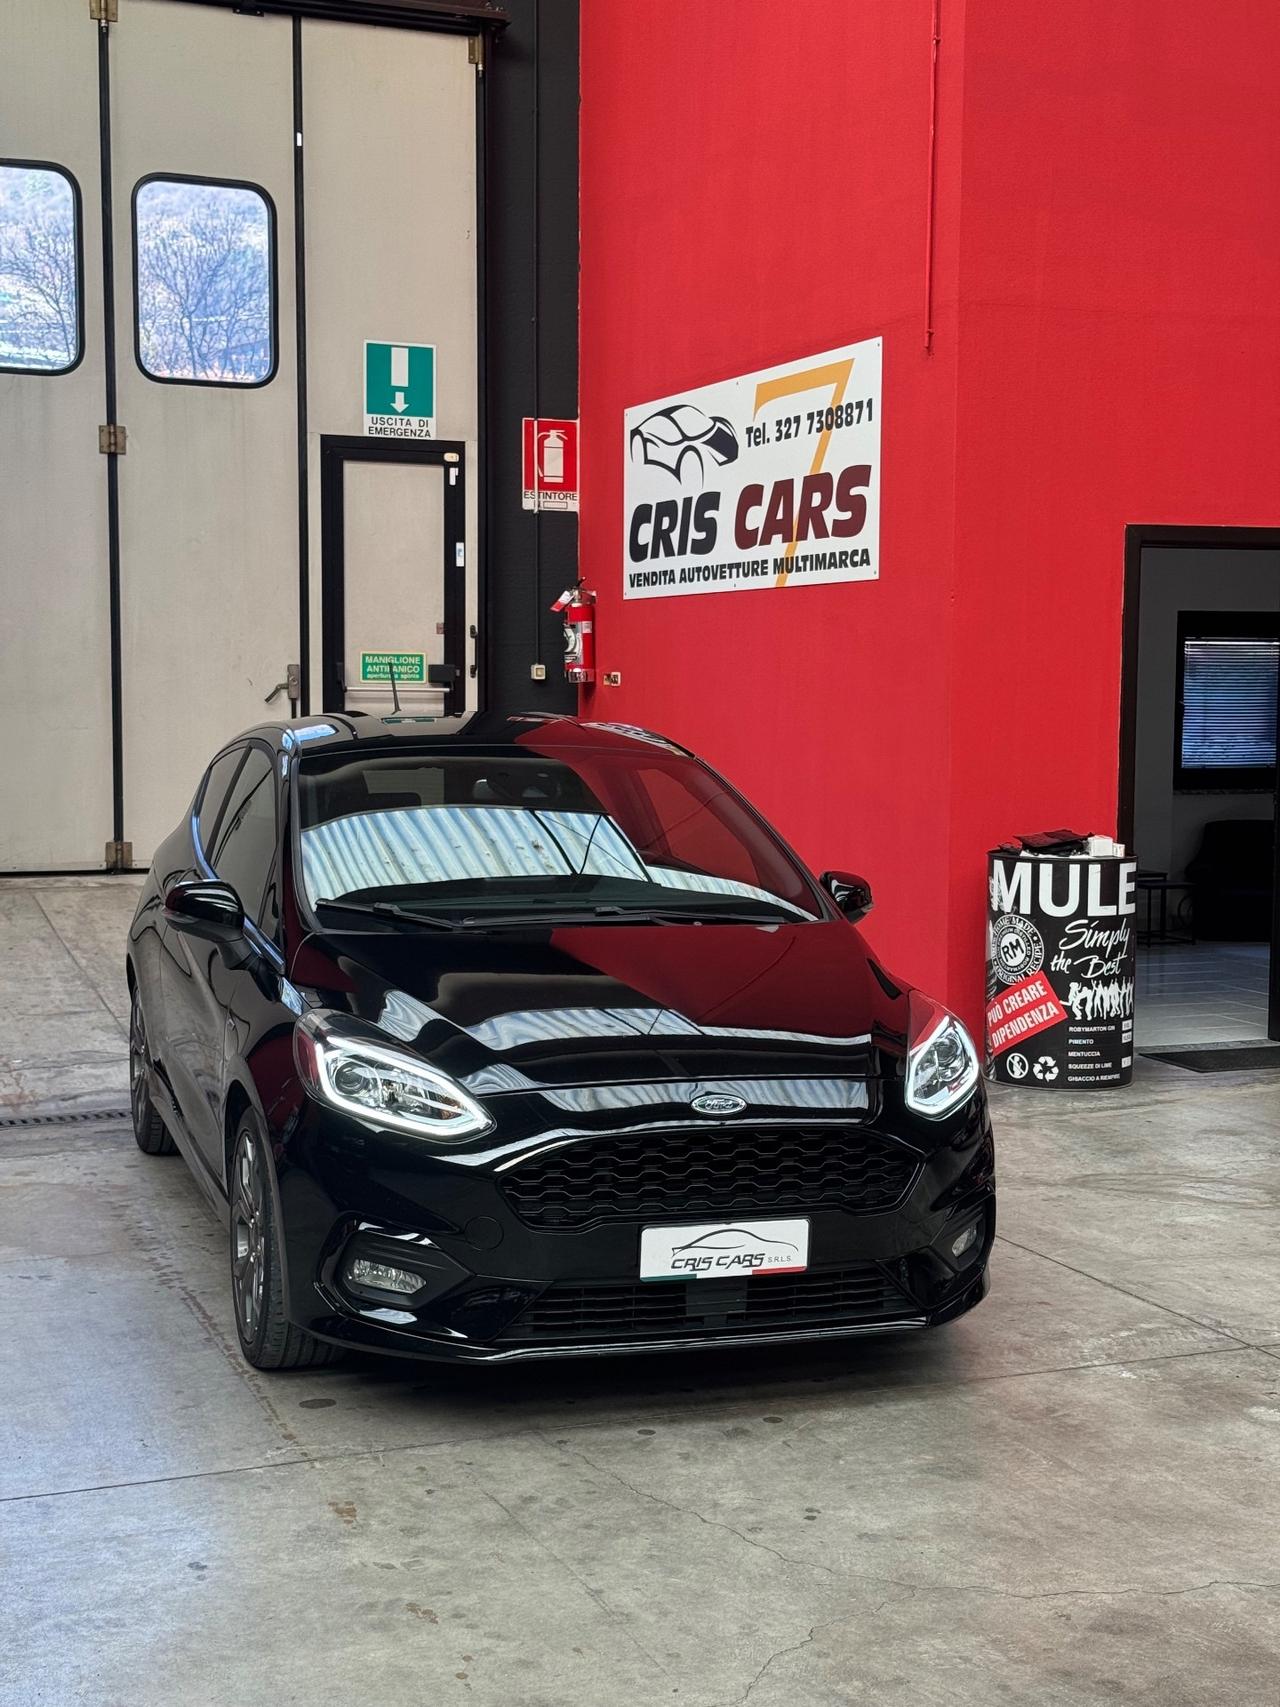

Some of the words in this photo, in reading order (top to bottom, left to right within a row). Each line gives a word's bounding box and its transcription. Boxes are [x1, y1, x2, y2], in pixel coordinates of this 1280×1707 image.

[368, 426, 431, 438] EMERGENZA
[371, 416, 412, 427] USCITA
[418, 419, 429, 428] DI
[745, 422, 770, 449] Tel.
[775, 415, 801, 442] 327
[807, 398, 873, 433] 7308871
[628, 491, 721, 563] CRIS
[734, 464, 872, 551] CARS
[629, 569, 675, 588] VENDITA
[679, 559, 768, 584] AUTOVETTURE
[773, 548, 871, 575] MULTIMARCA
[365, 655, 421, 664] MANIGLIONE
[992, 859, 1137, 917] MULE
[1011, 917, 1034, 937] MADE
[1059, 917, 1130, 958] Simply
[1001, 938, 1024, 962] RM
[1050, 951, 1072, 974] the
[1073, 951, 1127, 978] Best
[987, 1001, 1003, 1027] PUÒ
[1002, 980, 1048, 1014] CREARE
[991, 1001, 1060, 1048] DIPENDENZA
[704, 1098, 734, 1110] Ford
[670, 1256, 713, 1272] CRIS
[716, 1253, 765, 1269] CARS
